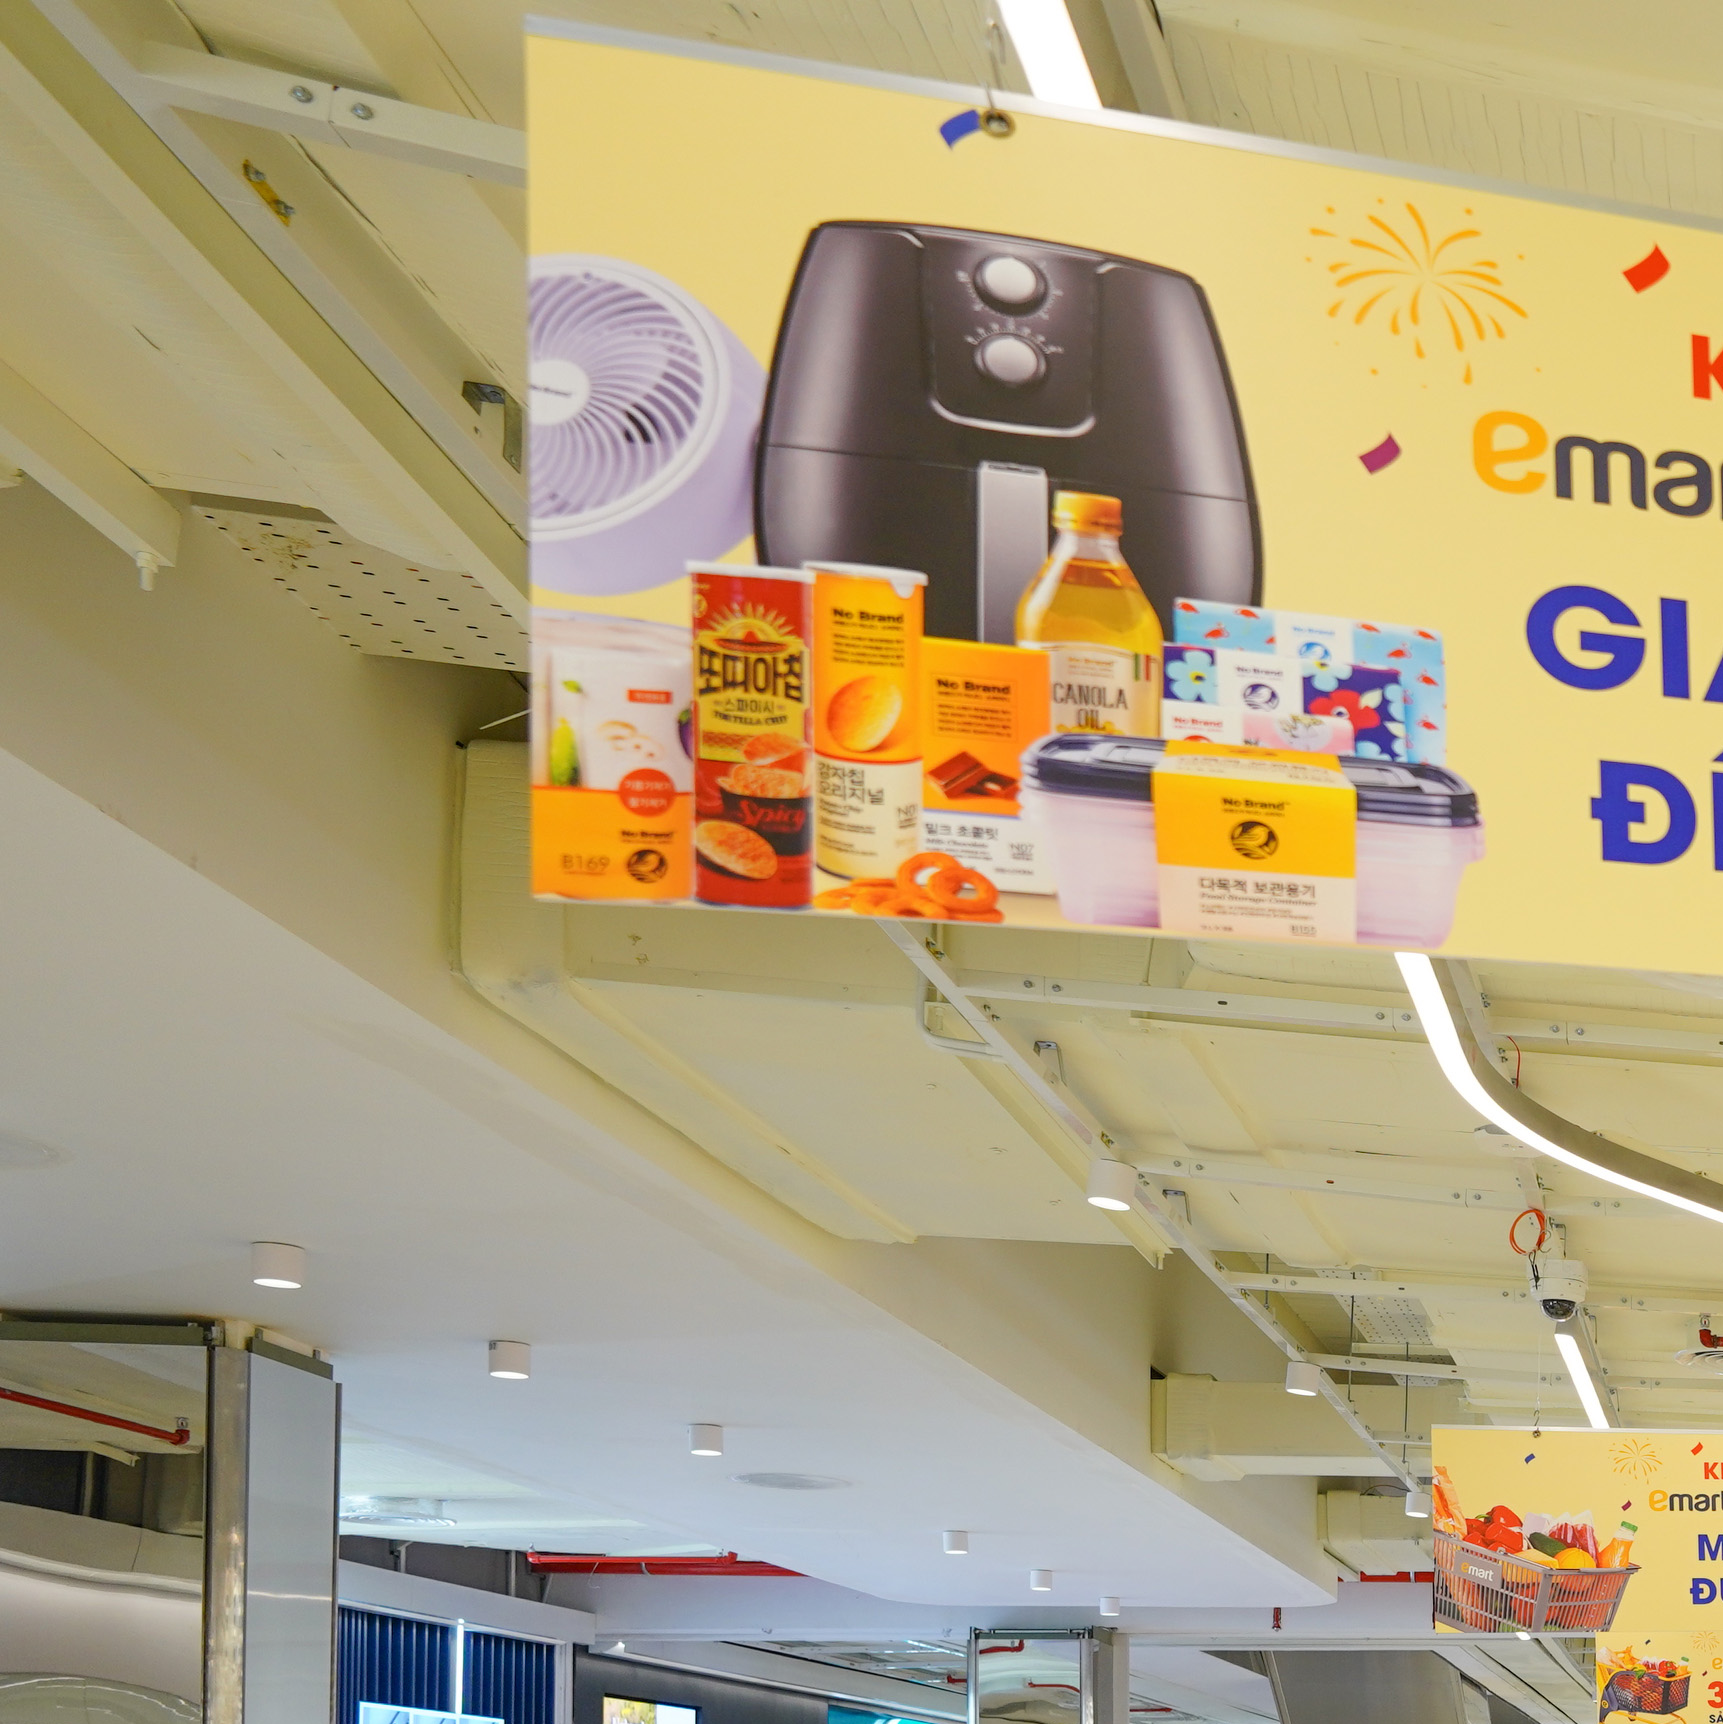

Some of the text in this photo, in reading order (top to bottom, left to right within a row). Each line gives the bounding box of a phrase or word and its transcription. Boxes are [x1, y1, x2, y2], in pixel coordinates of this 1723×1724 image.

[1053, 681, 1129, 710] CANOLA
[1077, 708, 1106, 731] OIL
[1461, 1562, 1494, 1582] emart
